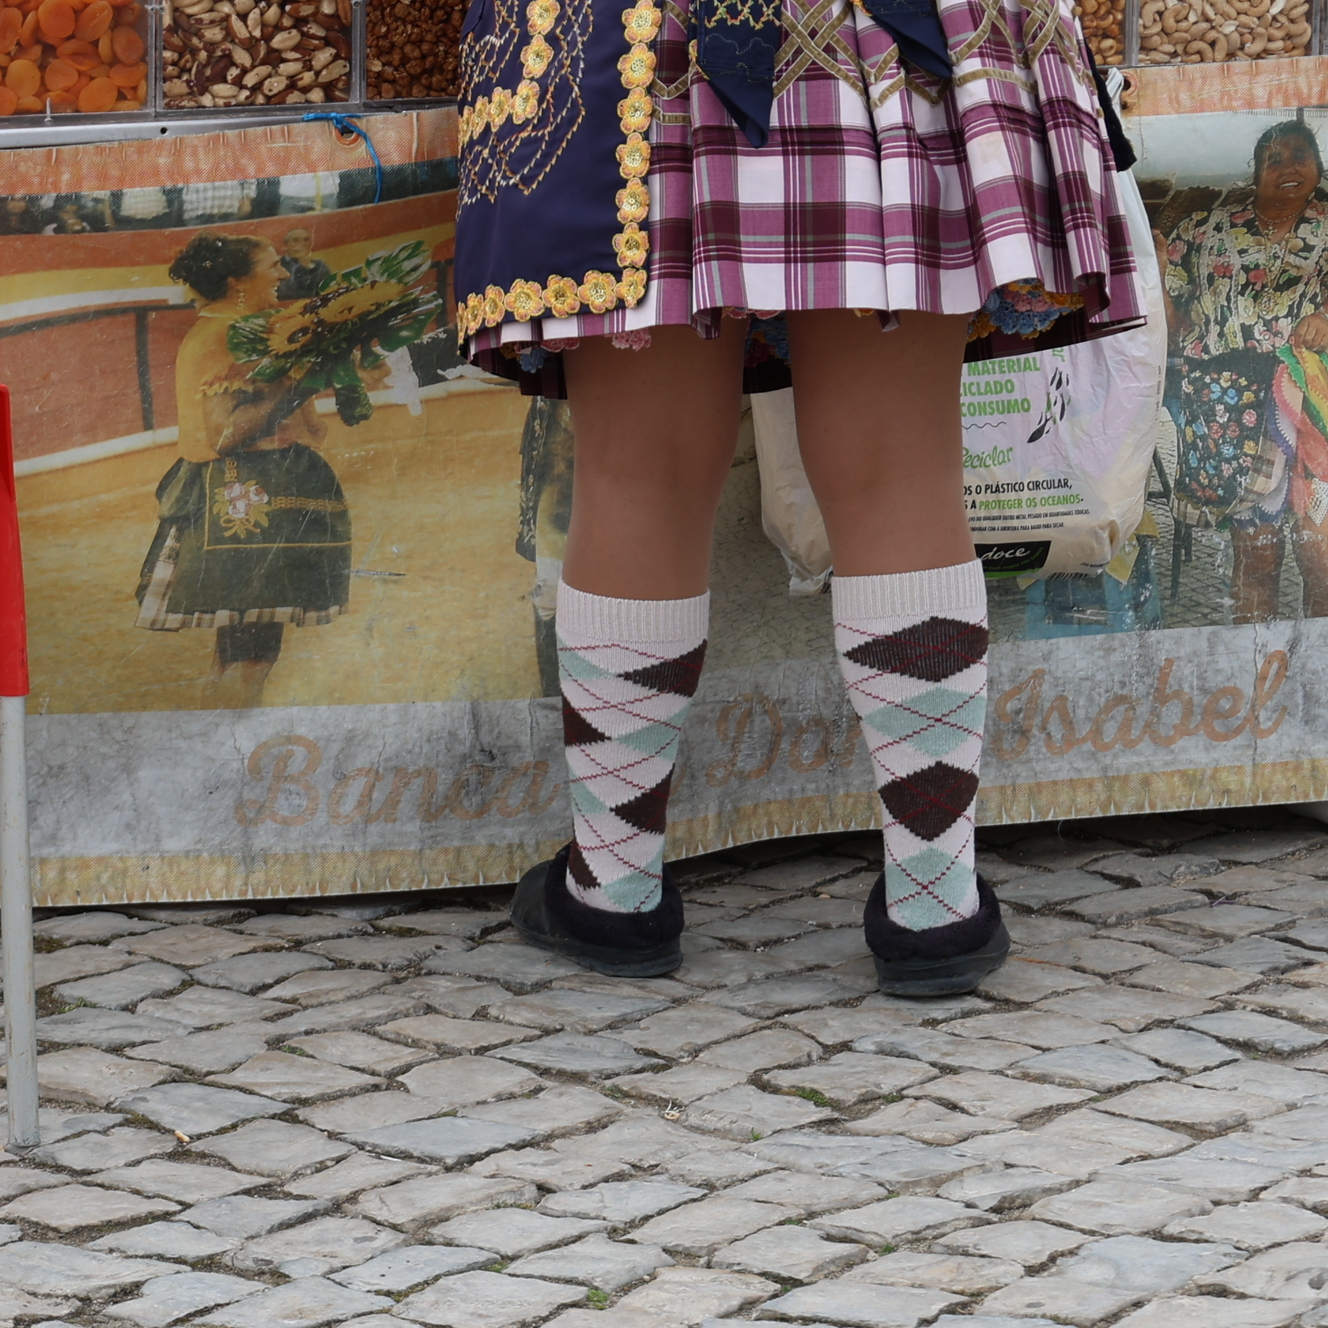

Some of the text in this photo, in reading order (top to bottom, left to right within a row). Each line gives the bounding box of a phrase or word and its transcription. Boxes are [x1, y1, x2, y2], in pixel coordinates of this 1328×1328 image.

[967, 356, 1041, 377] MATERIAL
[961, 379, 1015, 396] ICLADO
[960, 397, 1031, 418] CONSUMO
[975, 484, 982, 495] O
[984, 481, 1025, 494] PLÁSTICO
[1027, 478, 1073, 491] CIRCULAR,
[970, 493, 1084, 511] A PROTEGER OS OCEANOS.
[982, 546, 1031, 561] doce
[234, 648, 1290, 828] Banca Do Isabel
